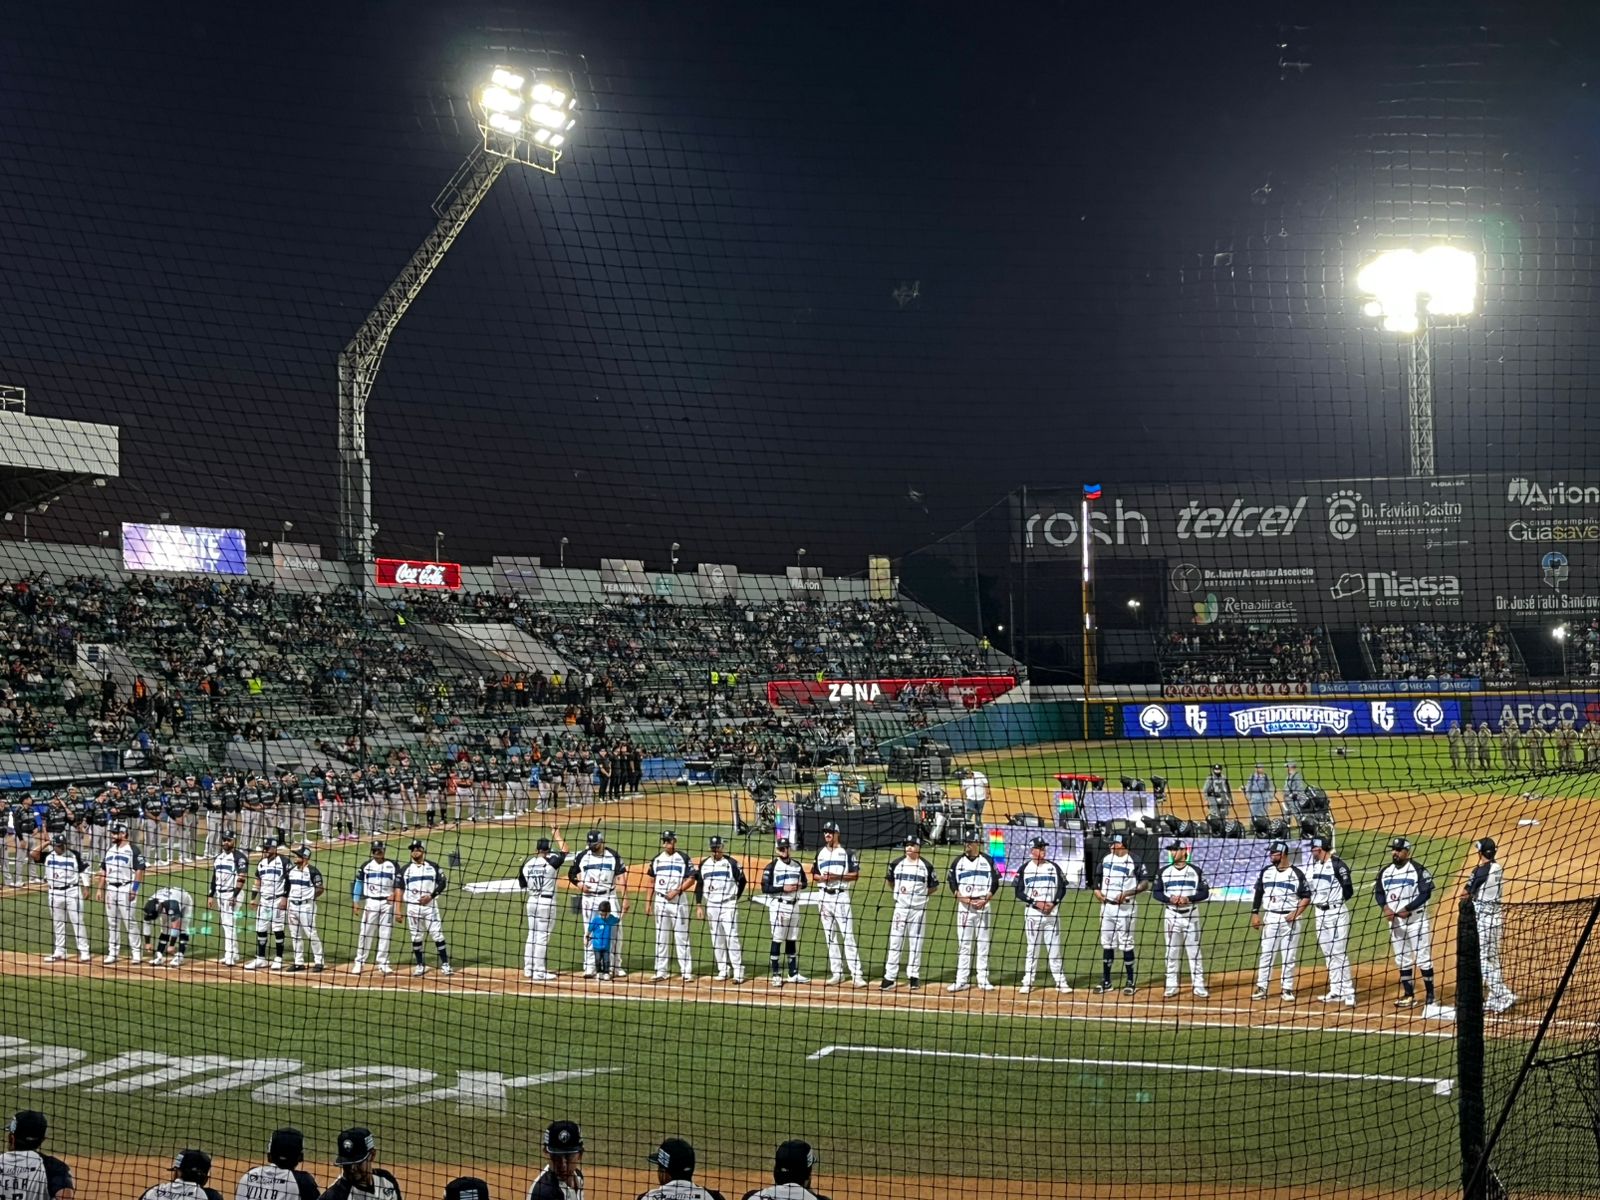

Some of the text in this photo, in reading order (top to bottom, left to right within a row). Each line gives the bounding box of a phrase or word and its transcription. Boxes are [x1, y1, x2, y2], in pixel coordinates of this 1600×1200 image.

[1524, 481, 1600, 506] Arion
[1176, 498, 1309, 539] telcel
[1422, 501, 1462, 517] Castro
[395, 563, 446, 585] Coca-Cola
[1369, 597, 1397, 608] Enre
[1413, 599, 1420, 609] y
[1434, 596, 1460, 607] obra
[1498, 703, 1579, 727] ARCO
